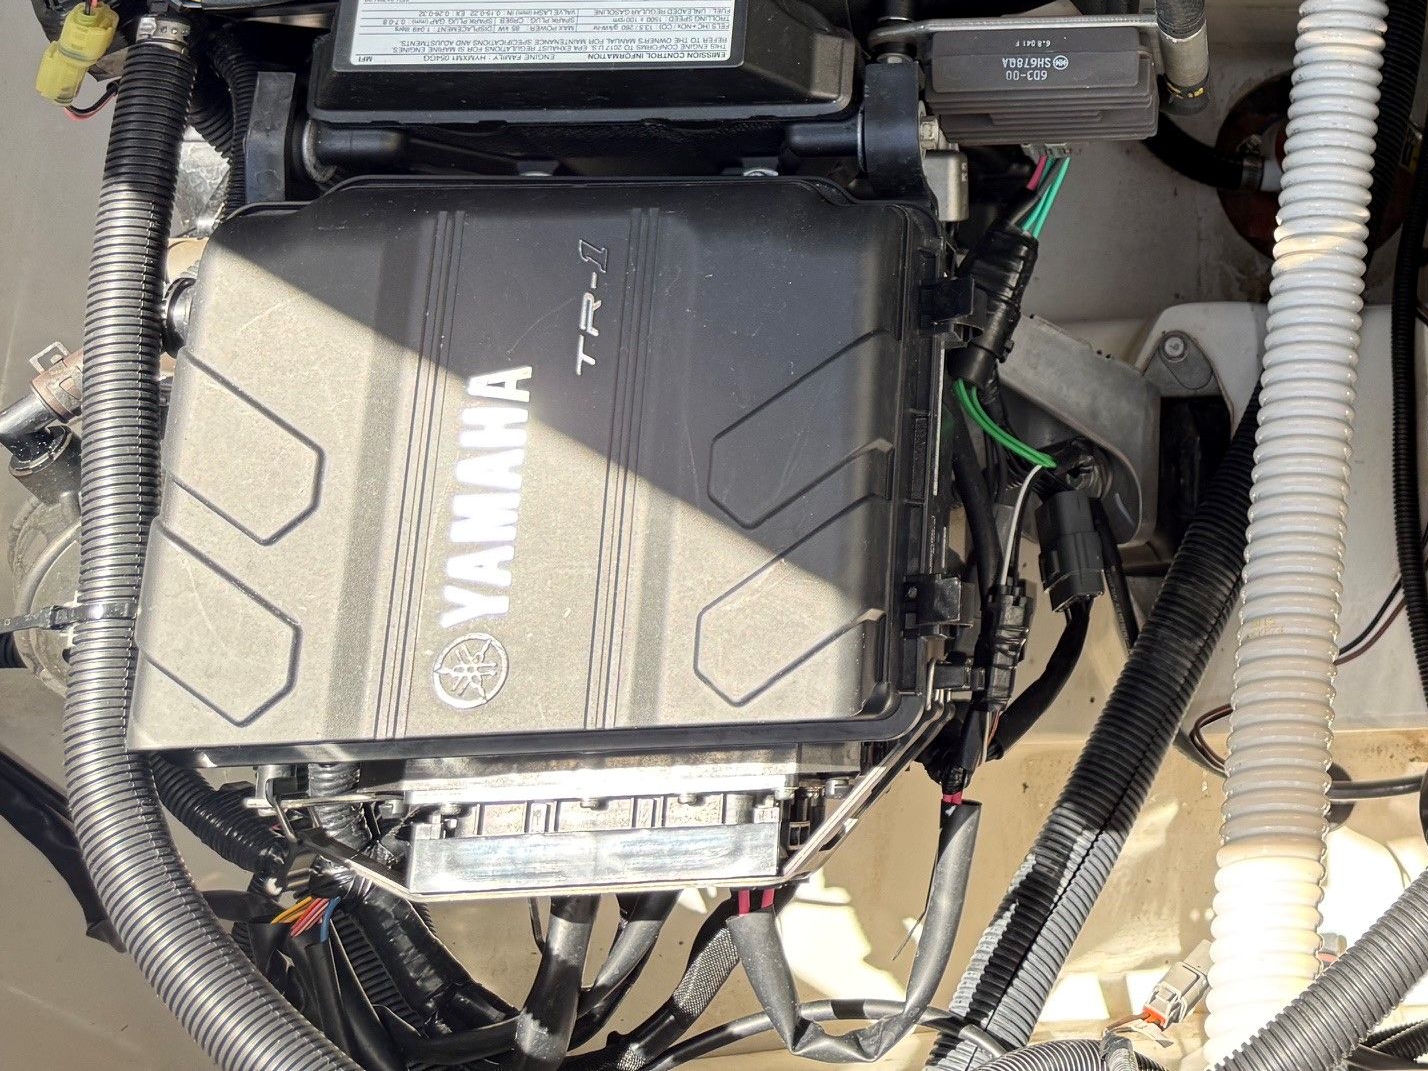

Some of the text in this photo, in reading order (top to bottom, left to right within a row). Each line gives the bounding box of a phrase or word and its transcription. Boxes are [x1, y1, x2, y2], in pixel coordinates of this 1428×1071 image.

[1002, 57, 1051, 68] SH678QA
[1006, 70, 1048, 81] 6D3-00
[576, 239, 608, 376] TR-1
[441, 366, 533, 628] YAMAHA
